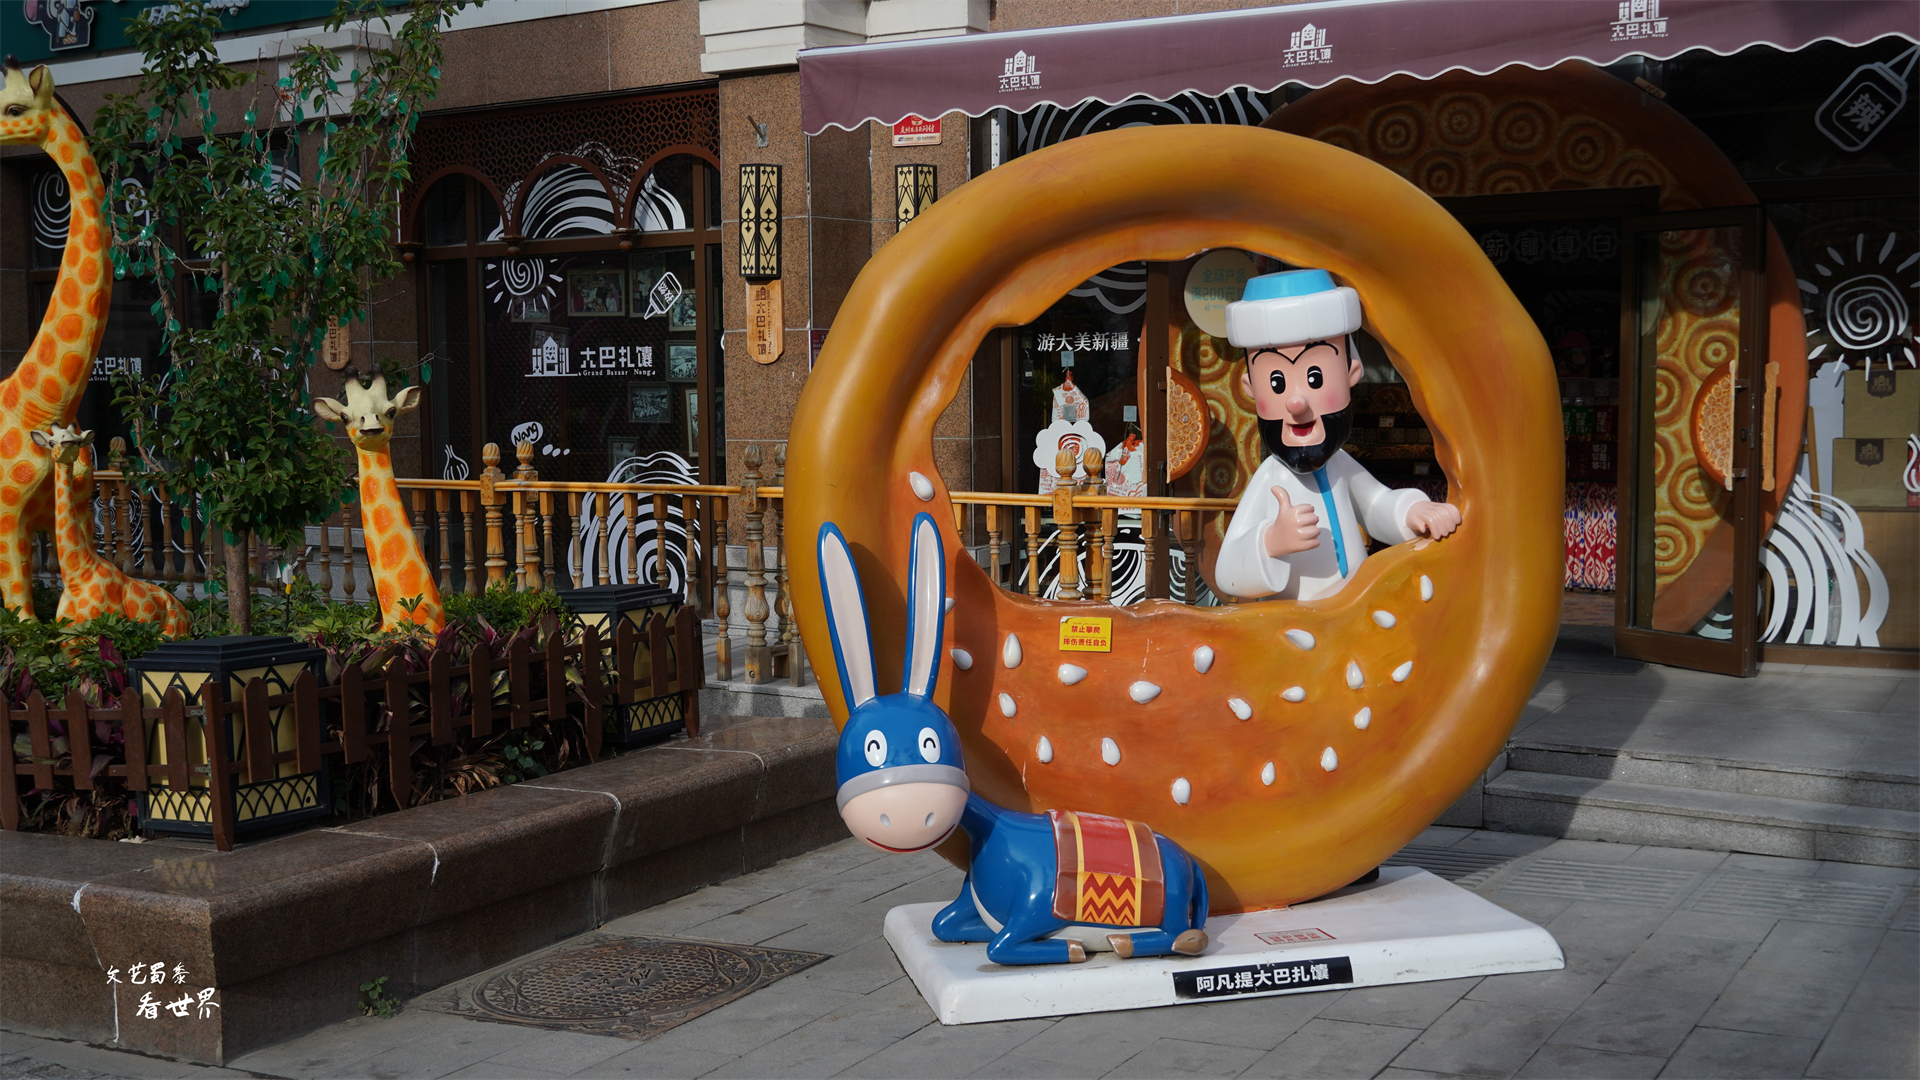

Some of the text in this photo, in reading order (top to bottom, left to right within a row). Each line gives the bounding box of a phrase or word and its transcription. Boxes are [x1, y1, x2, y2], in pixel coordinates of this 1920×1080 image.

[1611, 21, 1667, 38] 大巴扎馕
[1284, 48, 1331, 64] 大巴扎馕
[999, 74, 1040, 89] 大巴扎馕
[1842, 93, 1885, 132] 辣
[1202, 268, 1247, 284] 全场产品
[756, 302, 767, 356] 大巴扎馕
[1037, 332, 1130, 352] 游大美新疆
[580, 346, 653, 368] 大巴扎馕
[633, 368, 651, 377] Nang
[513, 422, 539, 447] Nang
[1071, 625, 1101, 634] 禁止攀爬
[1196, 963, 1330, 993] 阿凡提大巴扎馕
